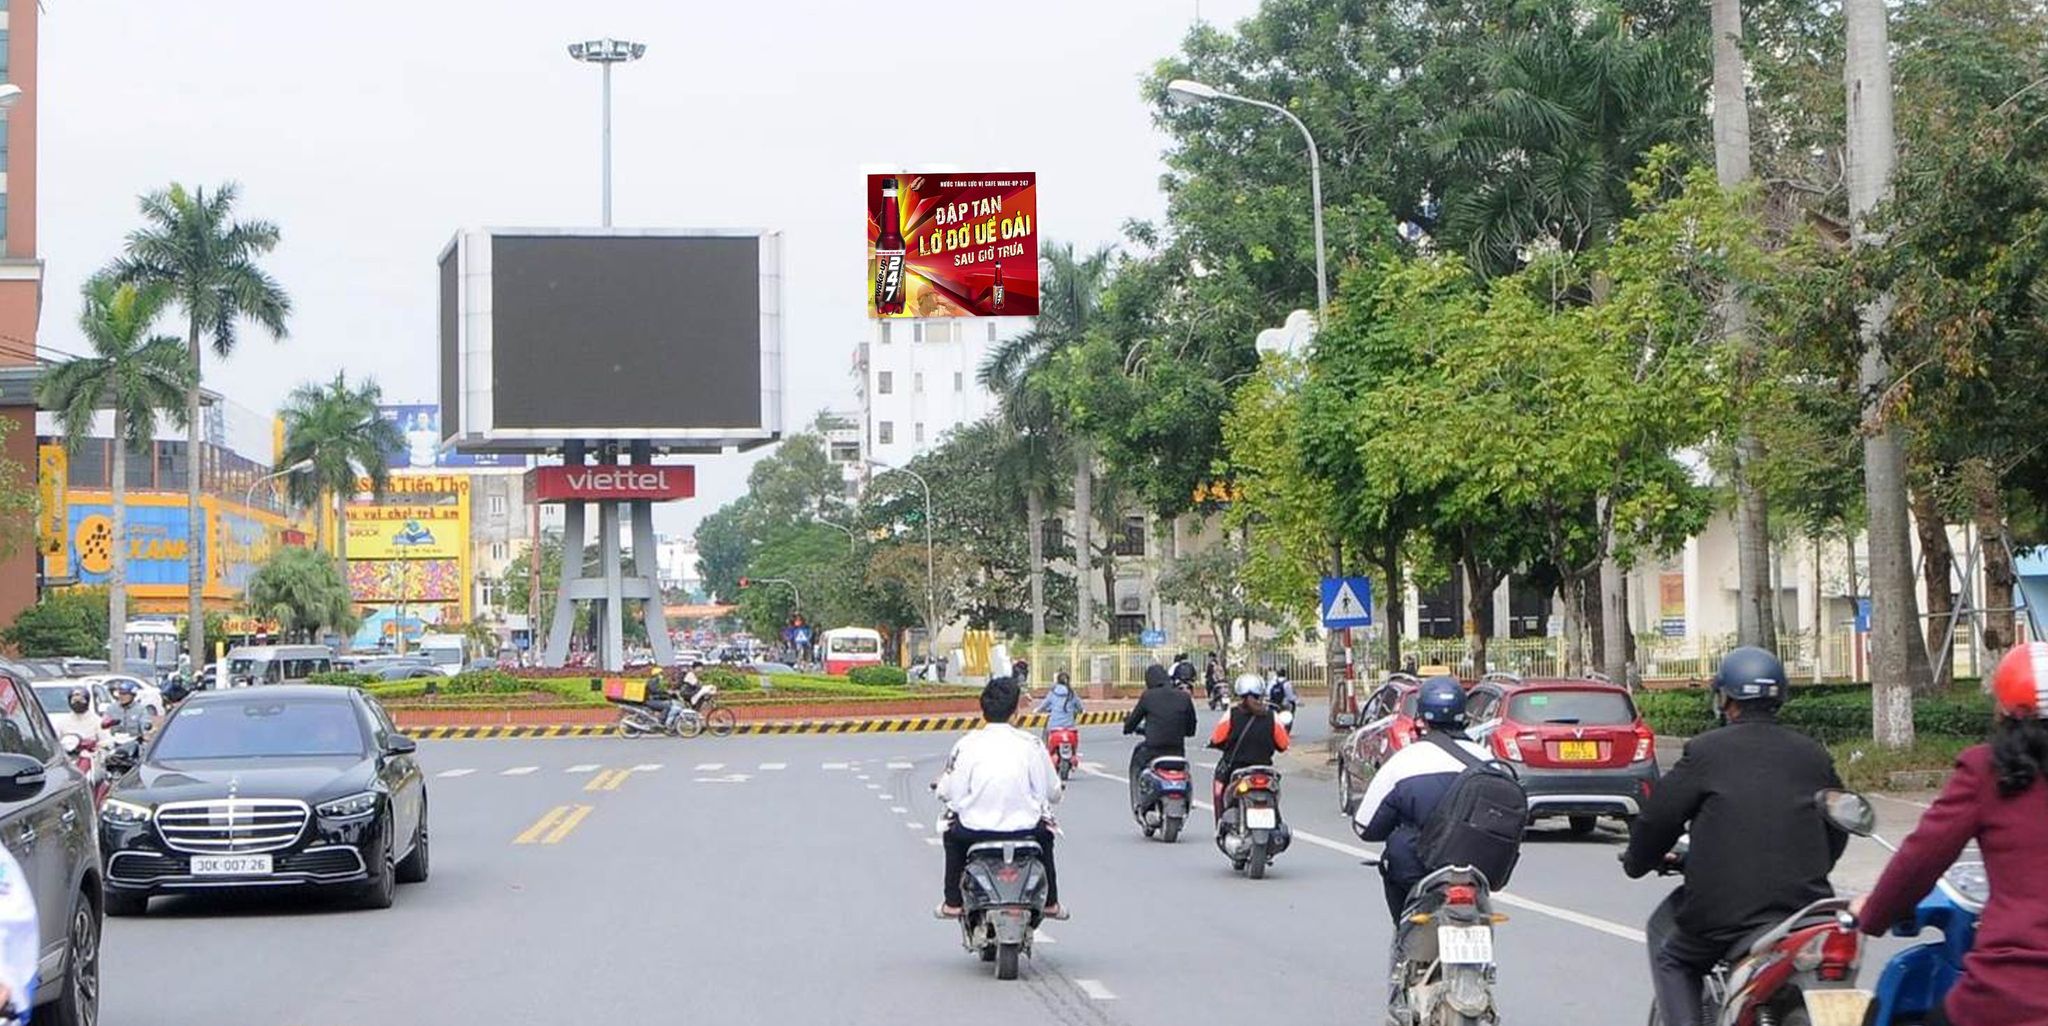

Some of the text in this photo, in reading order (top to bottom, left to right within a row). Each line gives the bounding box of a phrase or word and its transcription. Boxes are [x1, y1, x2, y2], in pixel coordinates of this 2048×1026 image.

[935, 194, 1002, 225] ĐẬP TAN
[919, 228, 943, 256] LỜ
[1001, 210, 1031, 240] OẢI
[954, 241, 1024, 267] SAU GIỜ TRƯA
[436, 475, 469, 496] Thọ
[566, 470, 670, 490] viettel
